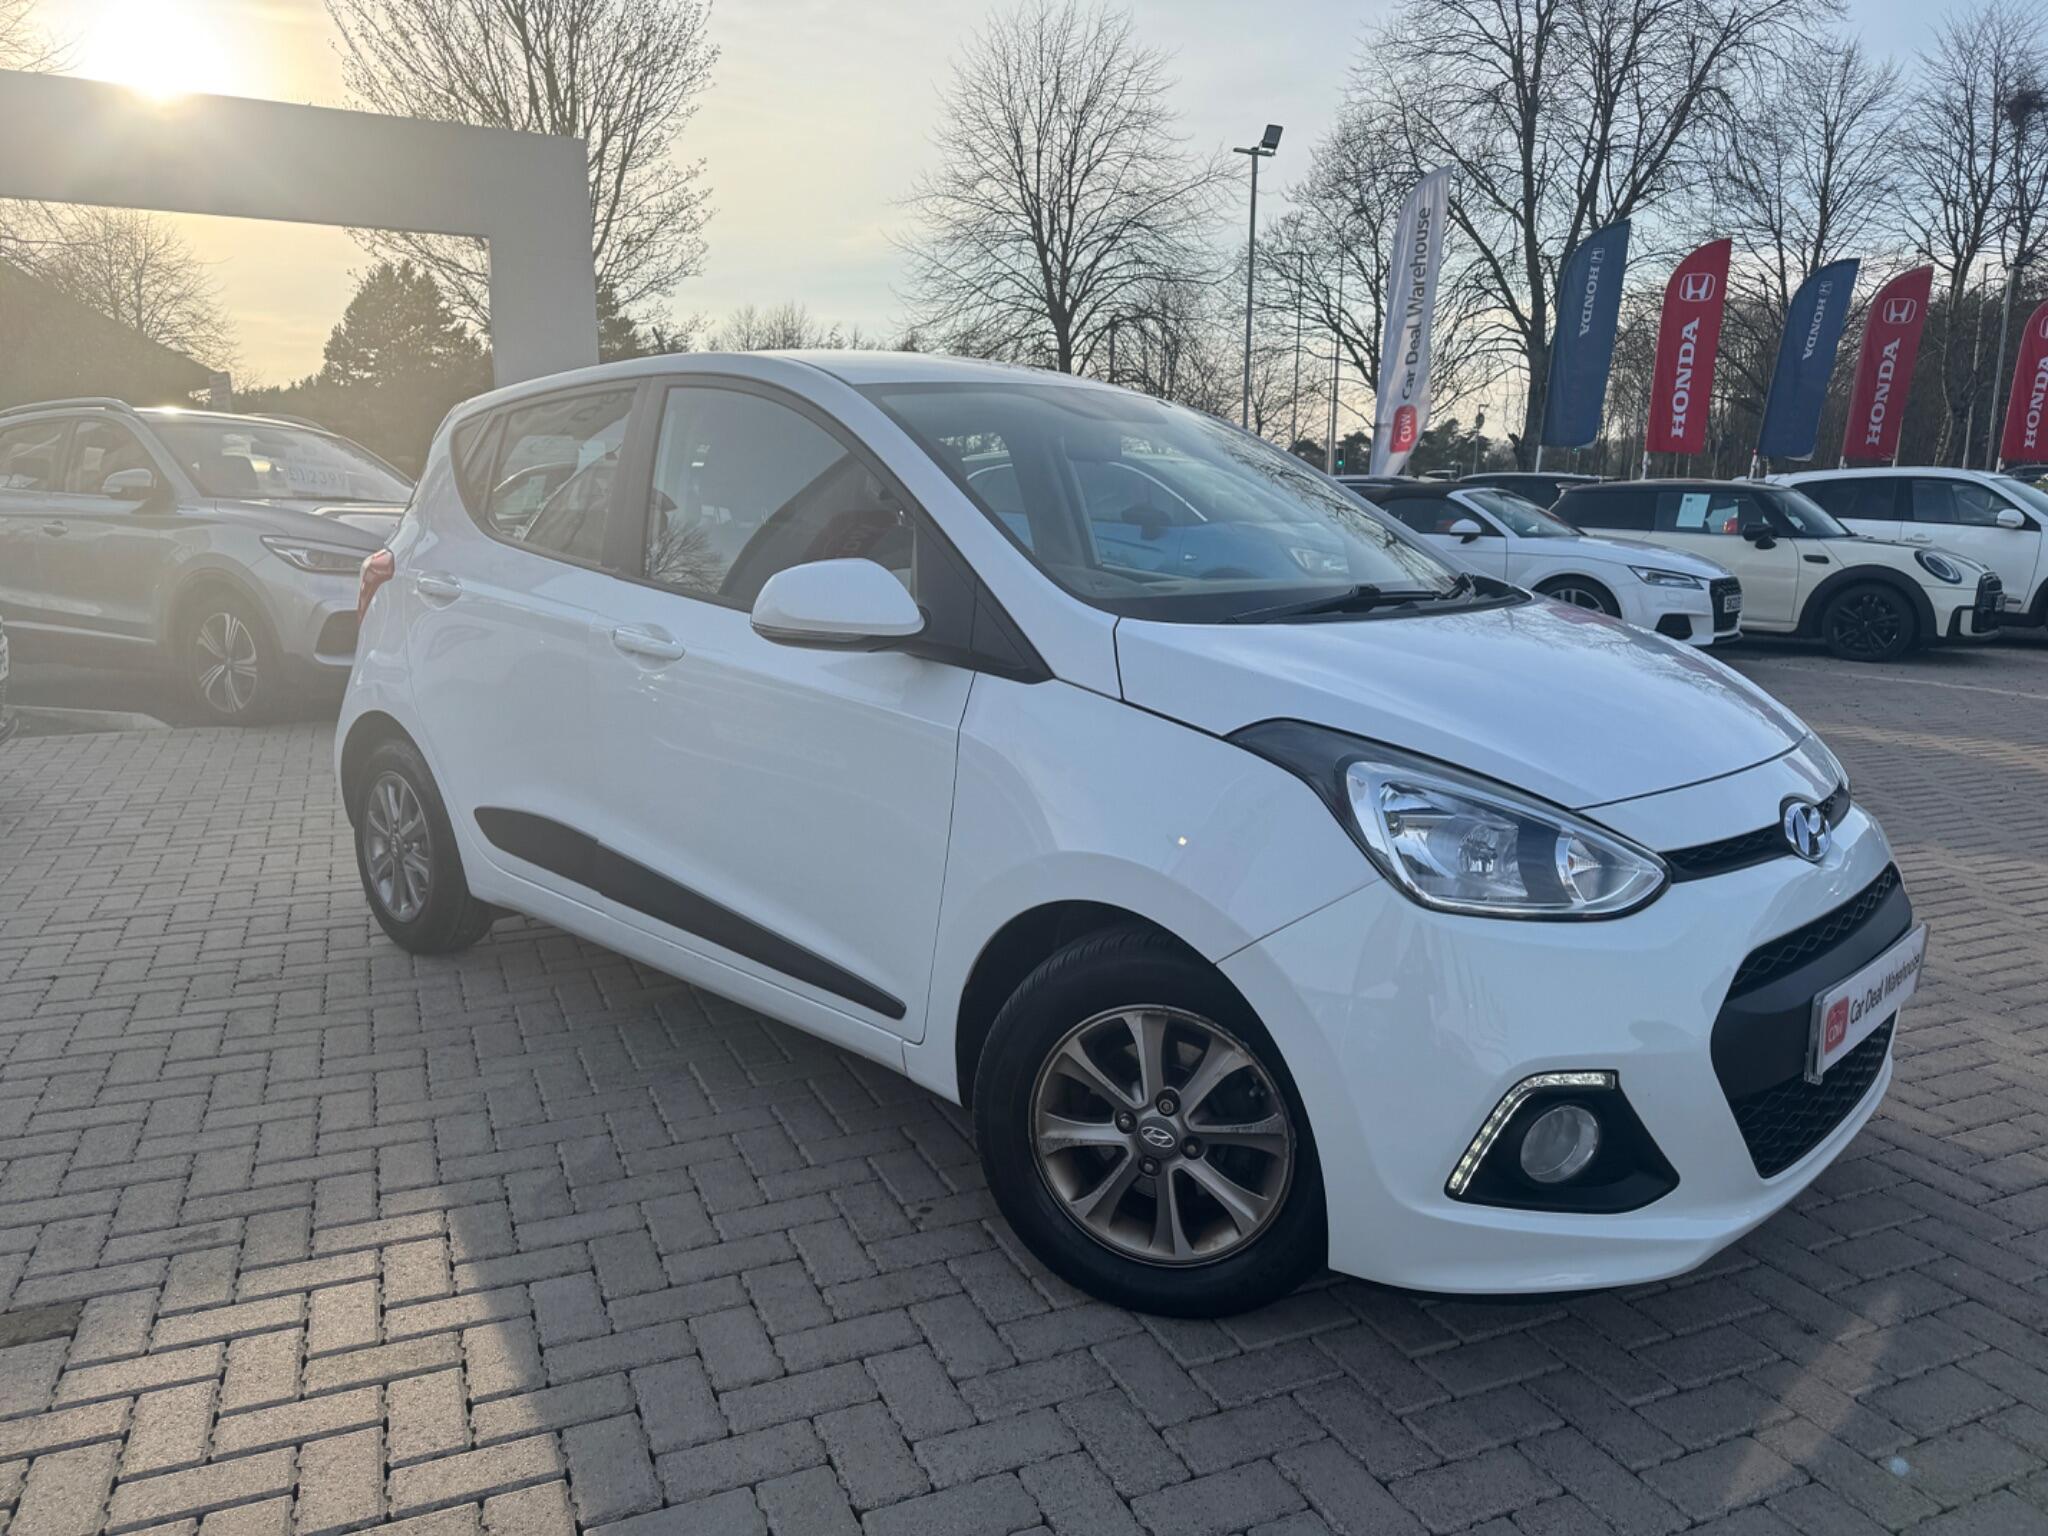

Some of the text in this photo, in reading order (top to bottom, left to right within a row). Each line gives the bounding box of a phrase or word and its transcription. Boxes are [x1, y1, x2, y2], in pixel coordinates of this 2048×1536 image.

[1401, 207, 1431, 443] CDW Car Deal Warehouse
[1579, 265, 1600, 337] HONDA
[1802, 298, 1826, 360] HONDA
[1671, 317, 1699, 437] HONDA
[1866, 338, 1901, 446] HONDA
[2024, 356, 2048, 448] HONDA
[1850, 999, 1864, 1024] Car
[1866, 978, 1883, 1014] Deal
[1885, 953, 1919, 998] Warehouse
